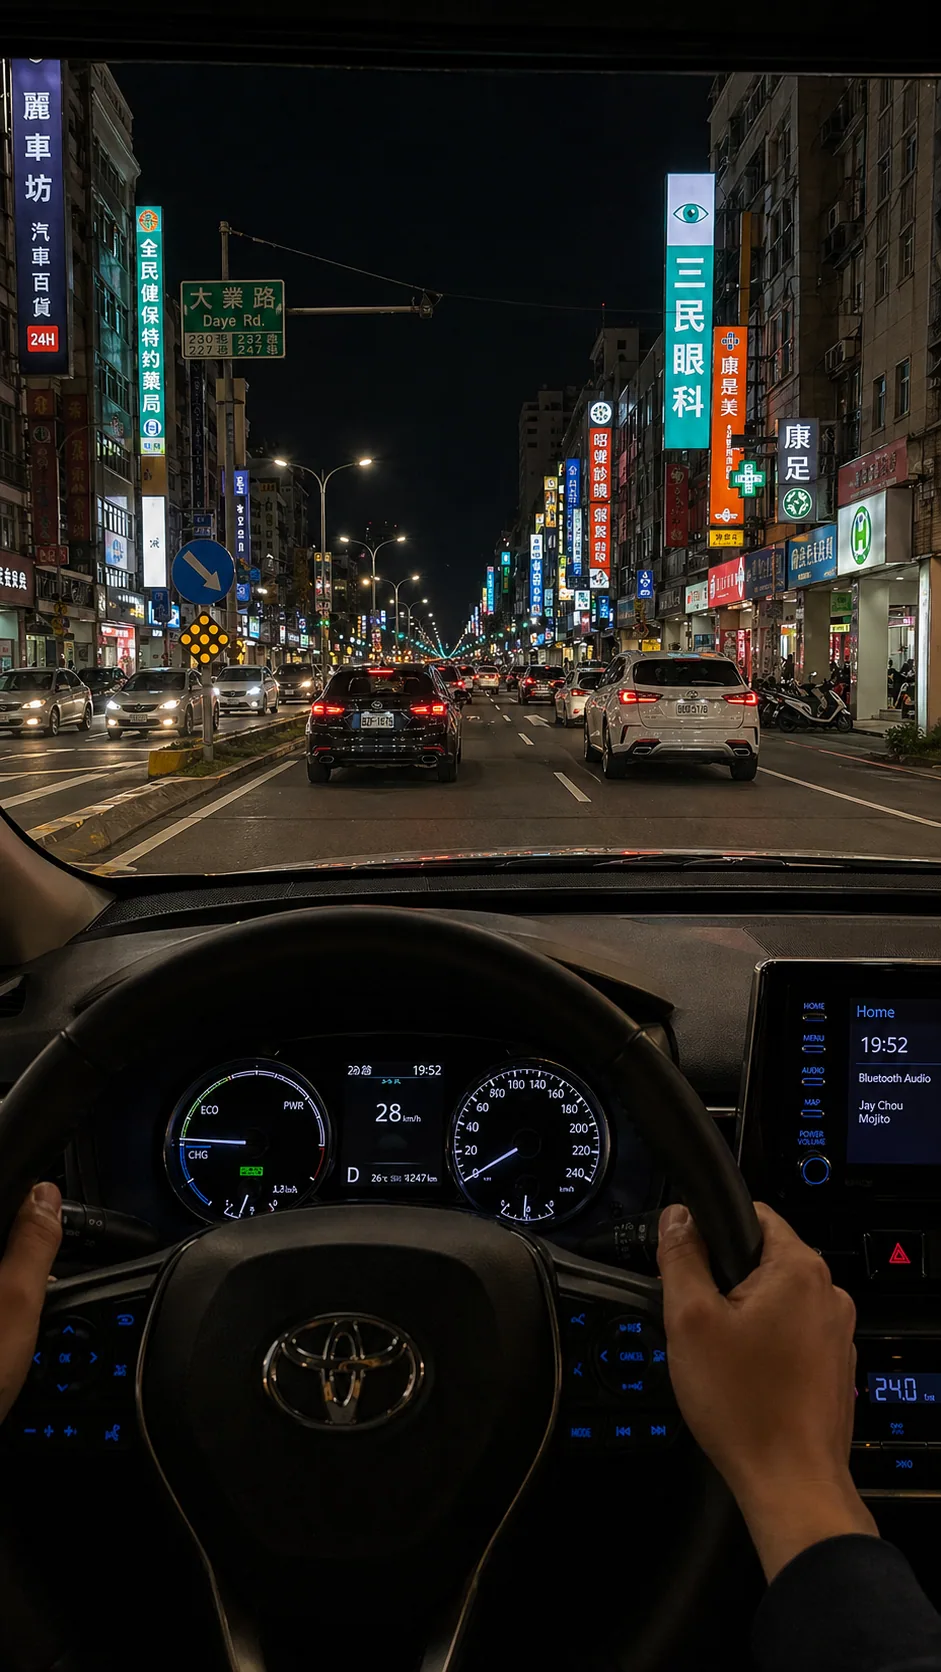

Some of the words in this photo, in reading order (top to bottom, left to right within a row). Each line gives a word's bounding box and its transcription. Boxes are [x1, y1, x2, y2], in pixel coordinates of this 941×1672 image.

[23, 91, 53, 203] 麗車坊
[31, 221, 51, 318] 汽車百貨
[190, 286, 276, 310] 大業路
[139, 238, 161, 414] 全民健保特約藥局
[203, 314, 237, 330] Daye
[243, 314, 265, 327] Rd.
[30, 332, 55, 346] 24H
[189, 334, 213, 344] 230
[237, 334, 262, 344] 232
[671, 257, 706, 418] 三民眼科
[189, 345, 213, 355] 227
[237, 345, 262, 355] 247
[720, 355, 739, 417] 康是美
[784, 423, 811, 482] 康足
[803, 1002, 825, 1010] HOME
[856, 1005, 895, 1018] Home
[803, 1034, 825, 1042] MENU
[861, 1036, 908, 1054] 19:52
[413, 1065, 442, 1076] 19:52
[801, 1066, 825, 1074] AUDIO
[858, 1072, 902, 1083] Bluetooth
[903, 1073, 932, 1083] Audio
[200, 1105, 219, 1115] ECO
[283, 1101, 304, 1110] PWR
[476, 1102, 489, 1112] 60
[561, 1104, 578, 1114] 180
[858, 1100, 876, 1112] Jay
[877, 1100, 904, 1110] Chou
[375, 1103, 402, 1122] 28
[858, 1113, 891, 1126] Mojito
[466, 1122, 479, 1132] 40
[569, 1123, 588, 1134] 200
[188, 1150, 209, 1160] CHG
[464, 1145, 478, 1155] 20
[572, 1145, 590, 1155] 220
[347, 1166, 360, 1183] D
[566, 1168, 585, 1178] 240
[875, 1377, 917, 1402] 24.0
